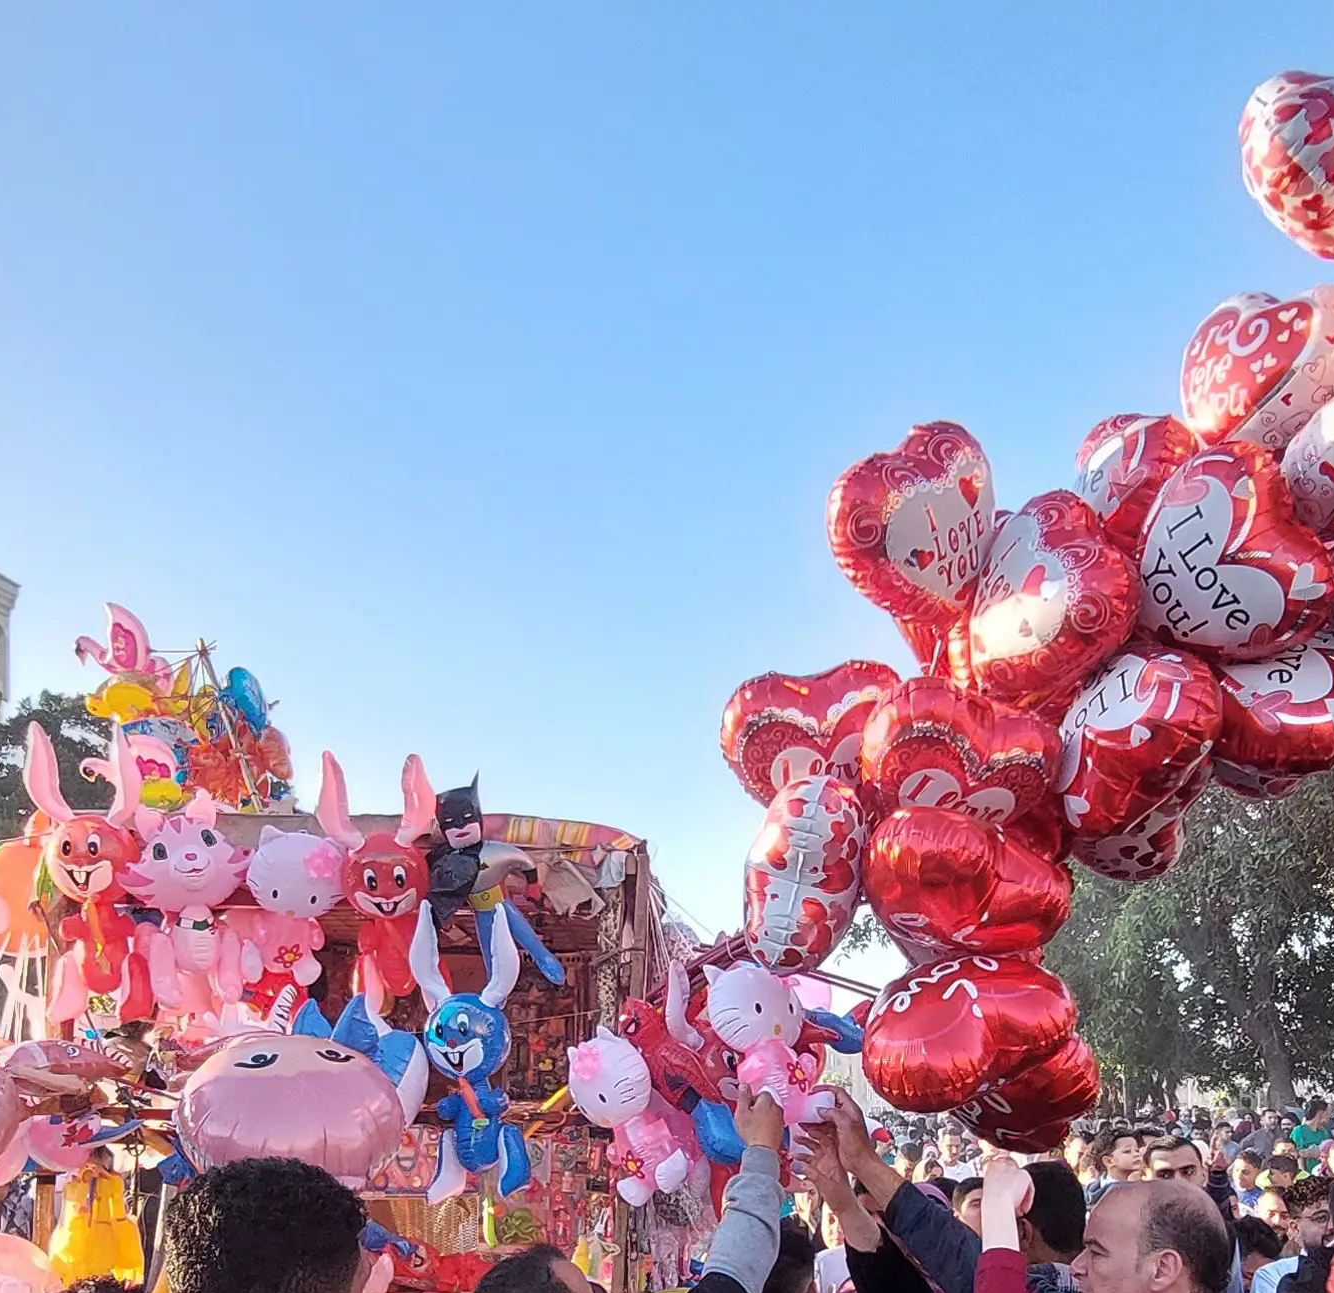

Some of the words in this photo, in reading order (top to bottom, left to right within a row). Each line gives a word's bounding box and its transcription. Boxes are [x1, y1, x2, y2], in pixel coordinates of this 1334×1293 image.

[924, 502, 937, 533] I
[933, 510, 985, 563] LOVE
[1166, 505, 1205, 541] I
[938, 545, 979, 588] YOU
[1178, 532, 1251, 631] Love
[1142, 548, 1209, 638] You!
[1268, 643, 1308, 684] ove
[1063, 686, 1108, 752] Lov
[907, 773, 935, 803] I
